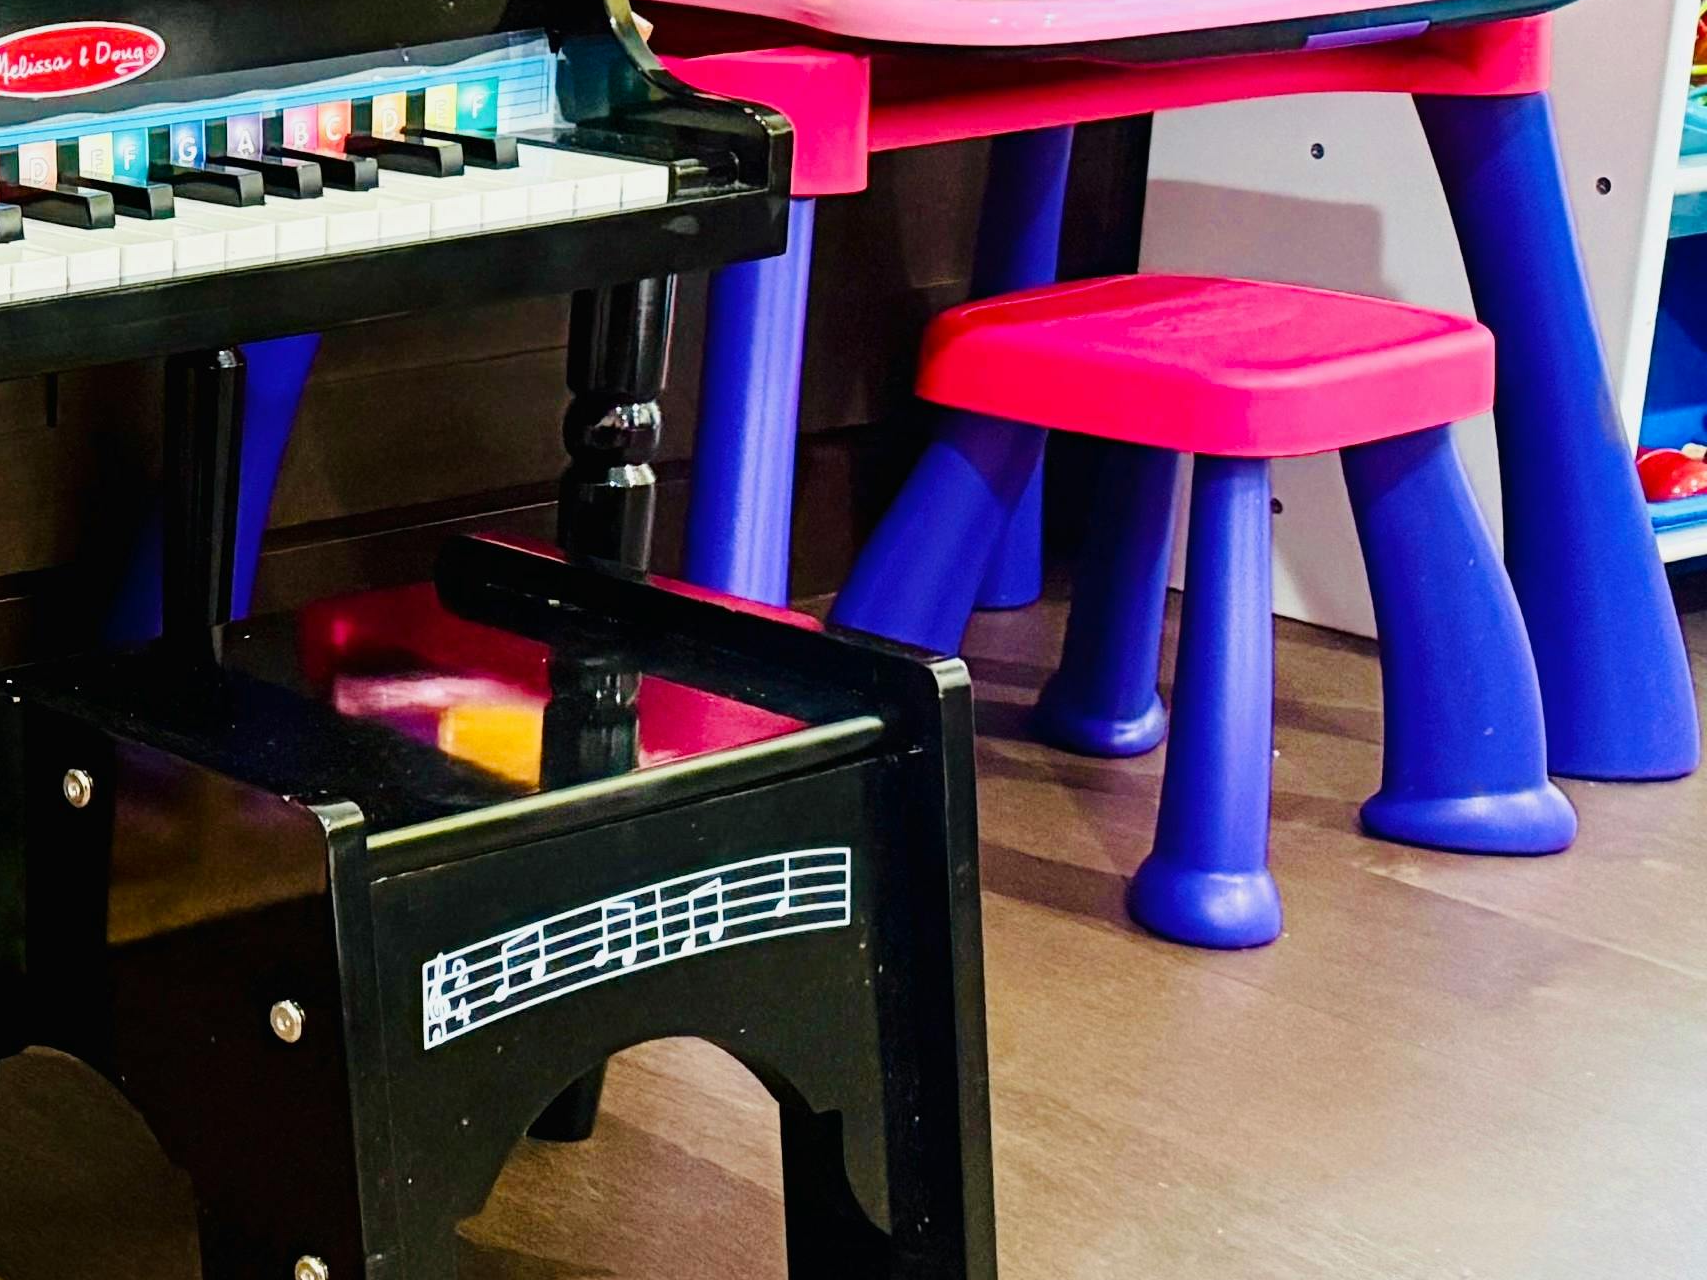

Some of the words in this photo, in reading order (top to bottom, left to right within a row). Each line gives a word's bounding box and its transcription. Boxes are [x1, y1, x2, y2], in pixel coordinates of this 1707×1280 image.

[29, 157, 49, 185] D
[122, 143, 138, 171] F
[177, 134, 198, 162] G
[237, 127, 255, 154] A
[292, 121, 308, 147] B
[325, 117, 342, 142] C
[381, 108, 398, 136] D
[470, 92, 486, 119] F
